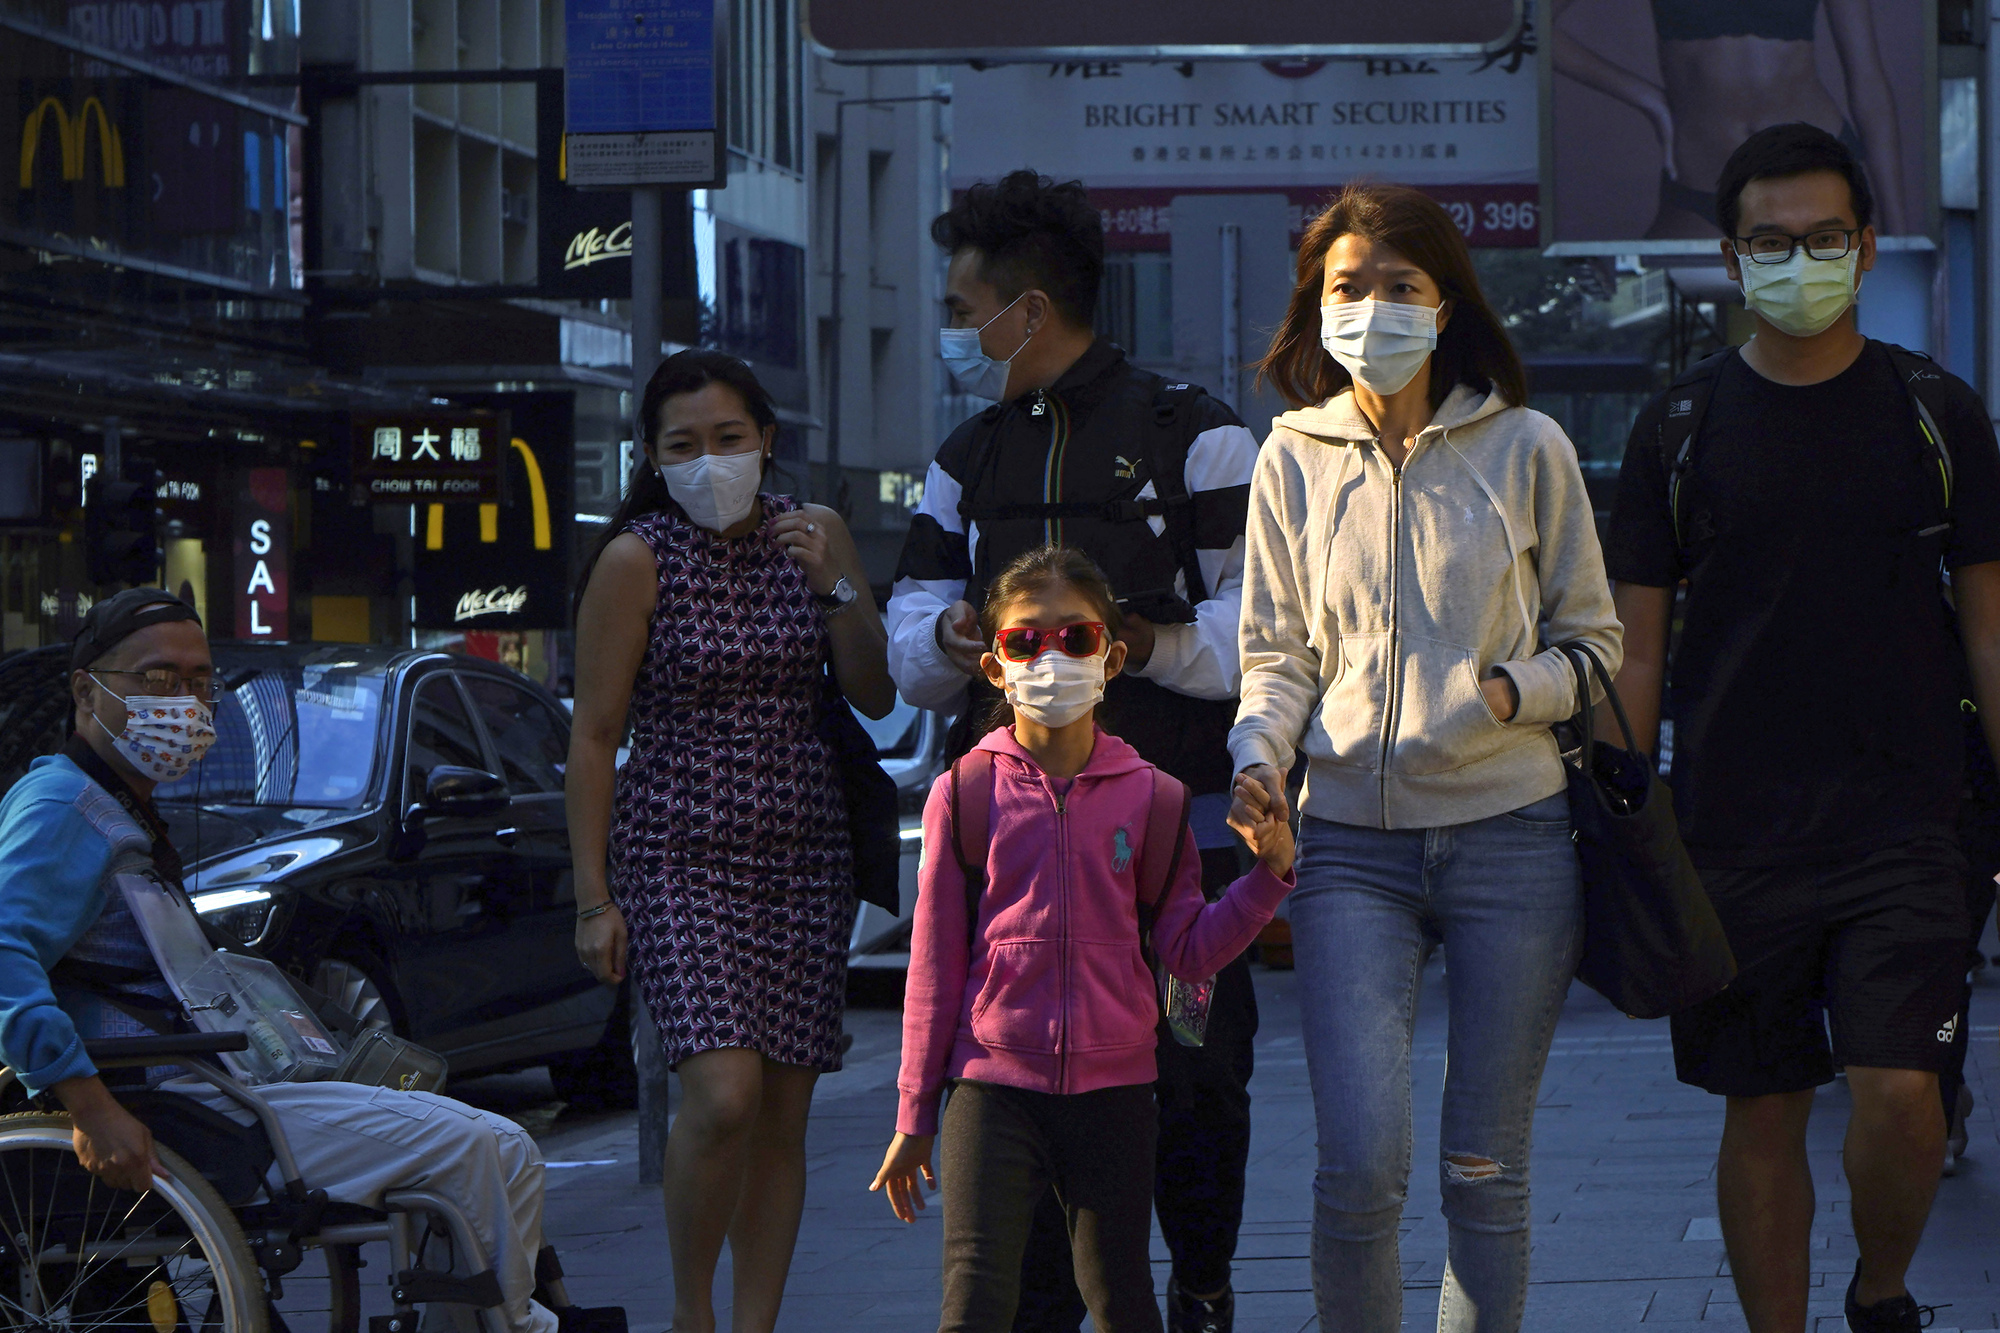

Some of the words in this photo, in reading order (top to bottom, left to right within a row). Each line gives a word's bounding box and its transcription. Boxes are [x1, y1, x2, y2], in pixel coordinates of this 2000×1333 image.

[1085, 103, 1202, 128] BRIGHT
[1214, 102, 1320, 127] SMART
[1332, 100, 1506, 125] SECURITIES
[1483, 202, 1539, 230] 396
[372, 426, 481, 461] 周大福
[371, 479, 412, 493] CHOW
[414, 479, 438, 493] TAI
[442, 479, 480, 493] FOOK
[270, 1048, 284, 1061] 50
